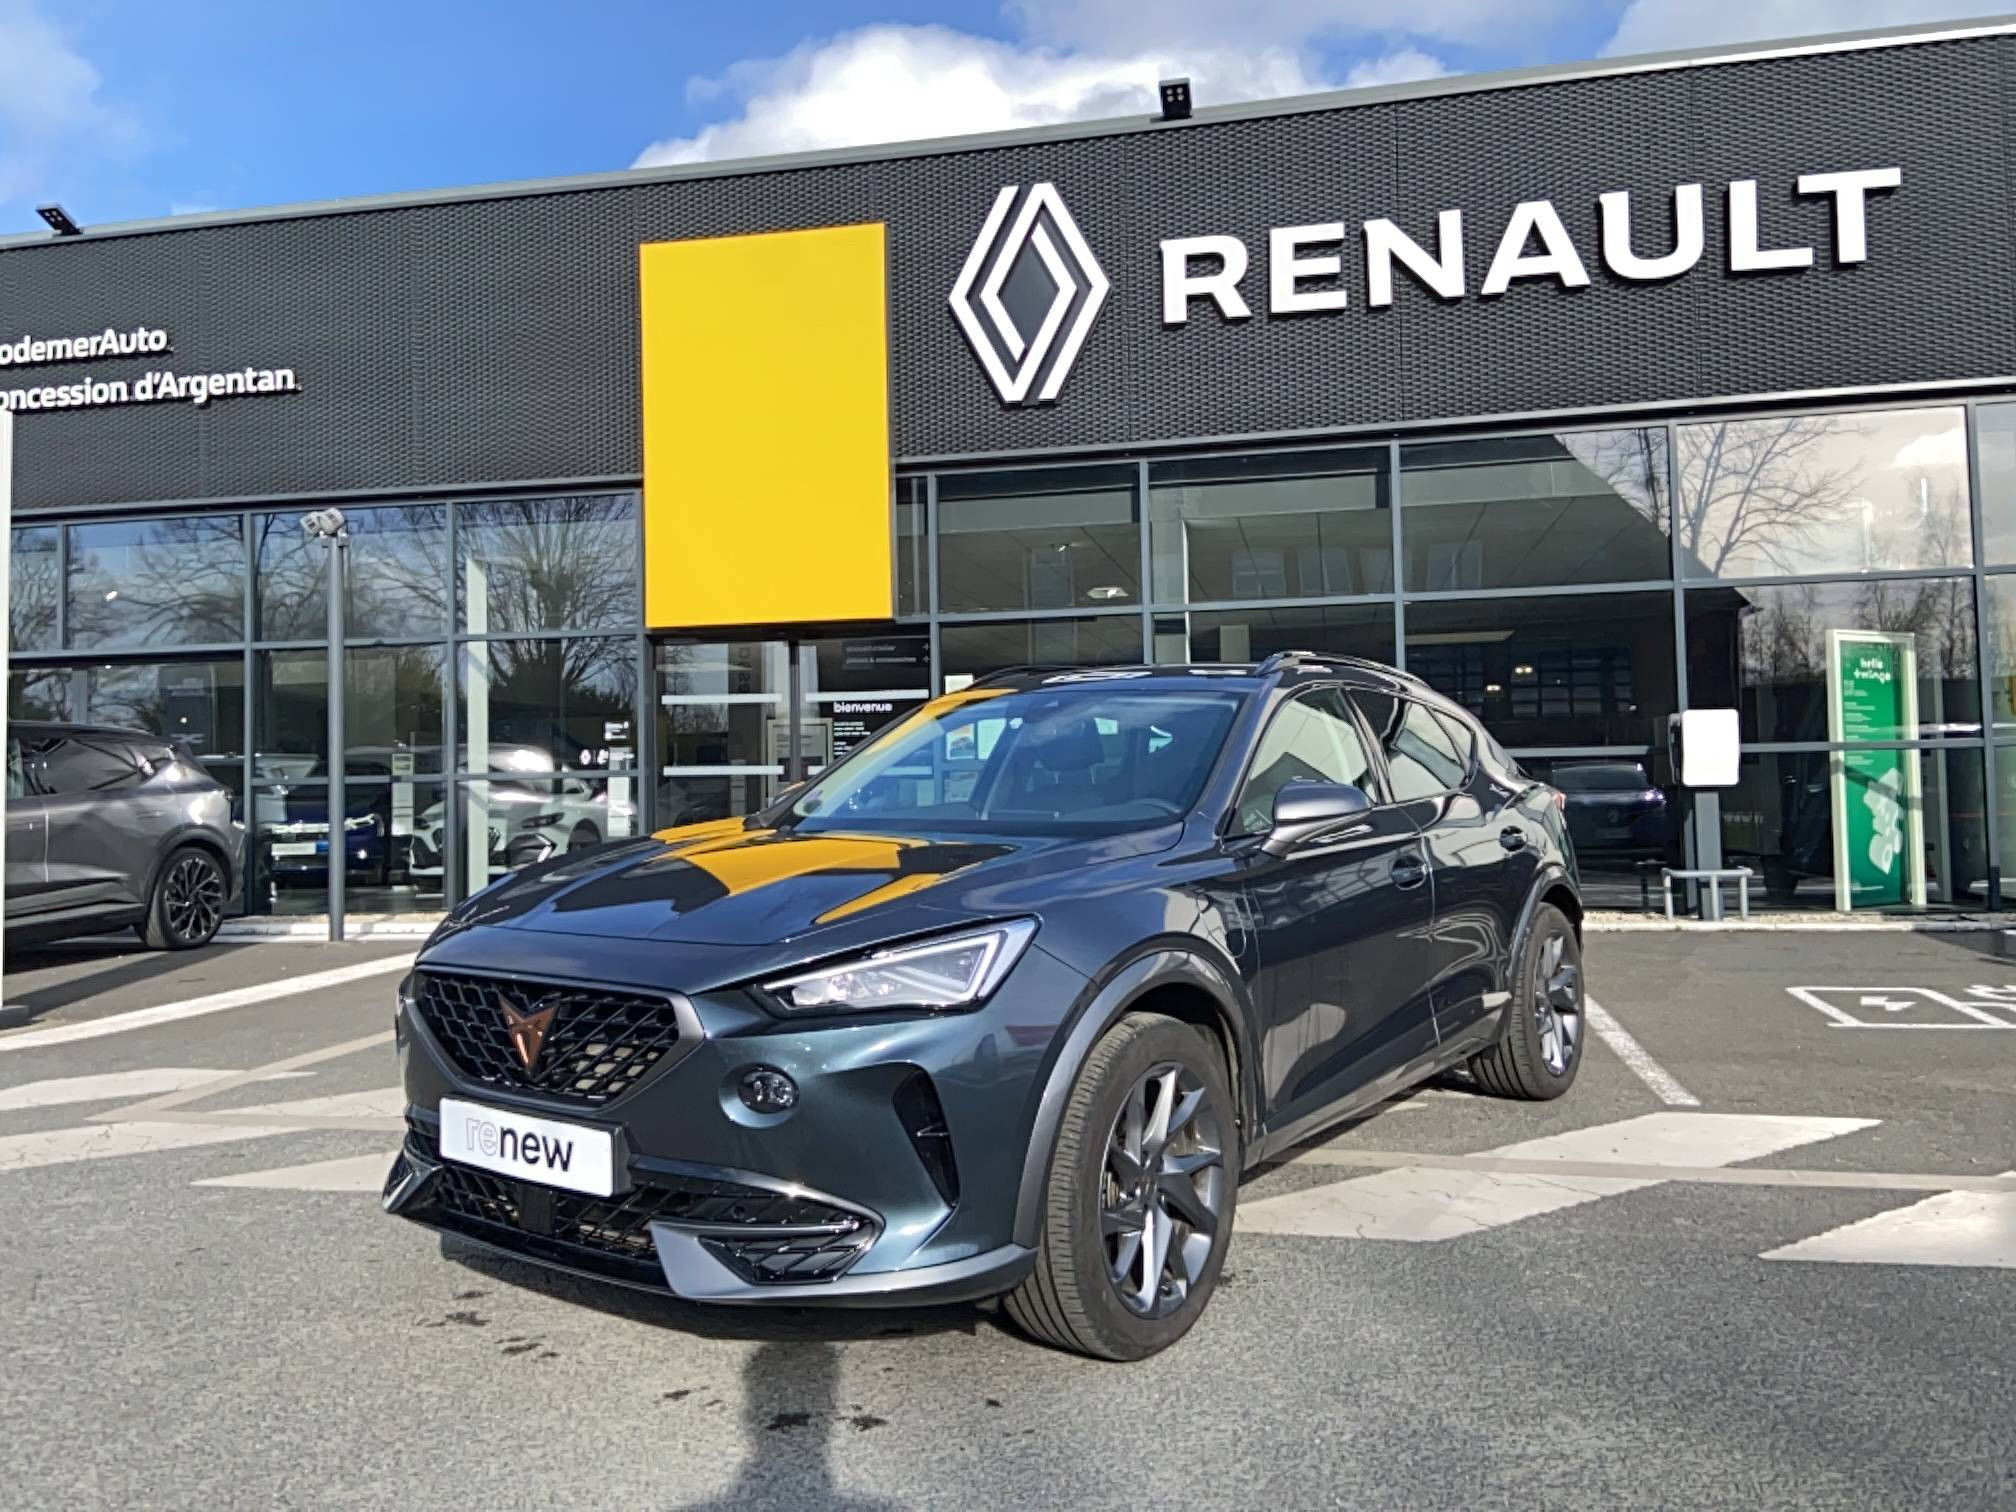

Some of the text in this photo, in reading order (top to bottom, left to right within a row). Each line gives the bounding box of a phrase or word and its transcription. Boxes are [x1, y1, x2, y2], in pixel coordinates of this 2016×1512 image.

[1160, 168, 1901, 324] RENAULT
[134, 367, 296, 404] d'Argentan
[832, 701, 893, 713] bienvenue
[466, 1118, 573, 1172] renew
